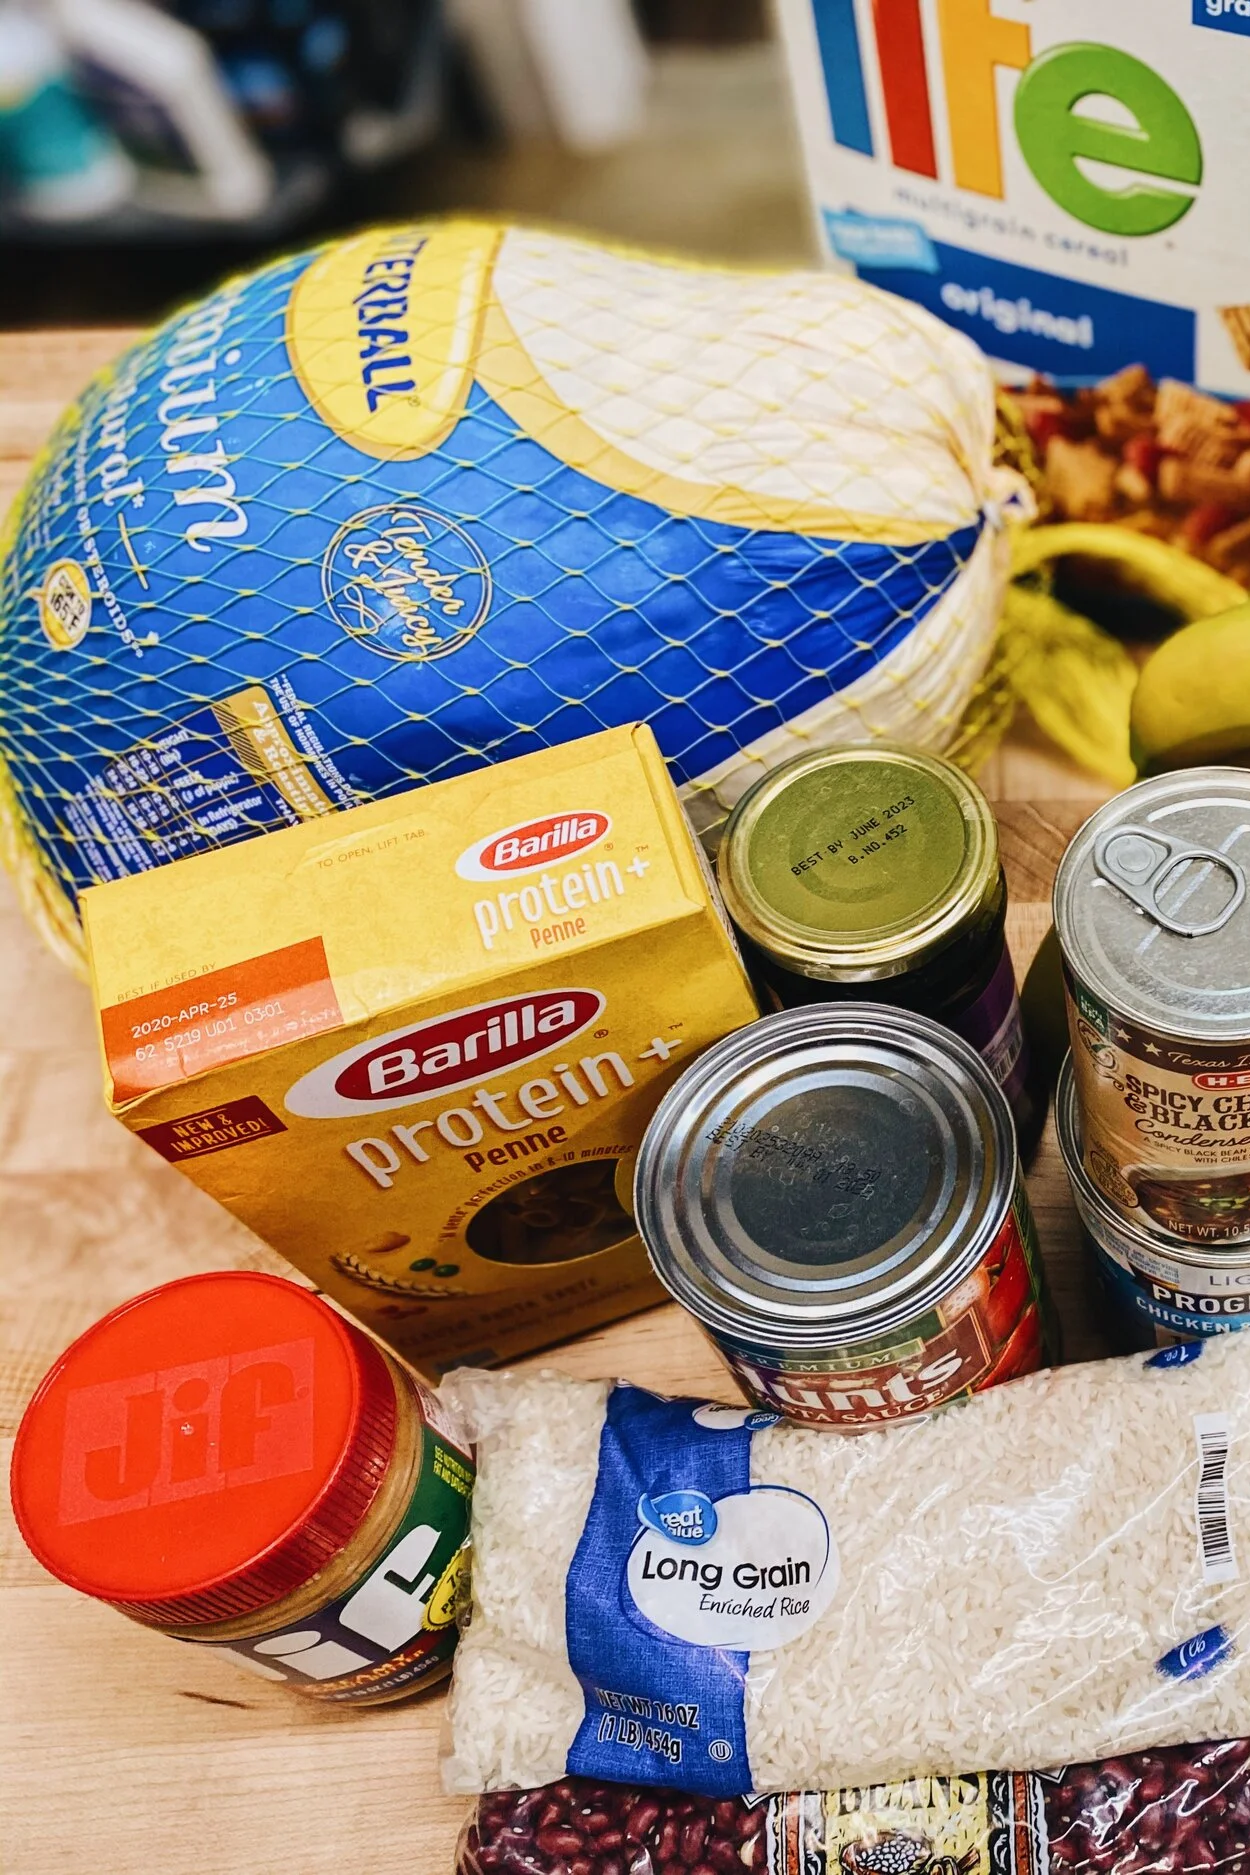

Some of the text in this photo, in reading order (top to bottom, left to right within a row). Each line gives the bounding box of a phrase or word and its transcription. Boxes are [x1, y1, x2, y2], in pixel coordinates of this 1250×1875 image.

[1043, 229, 1130, 268] cereal
[352, 236, 431, 414] TERBALL
[939, 281, 1095, 350] original
[380, 510, 466, 616] Tender
[294, 728, 328, 780] HORMNES
[318, 829, 425, 869] TO OPEN, LIFT TAB
[492, 817, 598, 868] Barilla
[791, 795, 916, 877] BEST BY JUNE 2023
[530, 917, 587, 949] Penne
[117, 960, 217, 1002] BEST IF USED BY
[131, 991, 238, 1039] 2020-APR-25
[135, 1043, 156, 1062] 62
[164, 1027, 202, 1051] 5219
[367, 994, 578, 1095] Barilla
[1167, 1049, 1231, 1070] Texas
[1123, 1091, 1148, 1115] &
[1124, 1073, 1204, 1112] SPICY
[170, 1116, 271, 1154] IMPROVED!
[173, 1111, 235, 1141] NEW &
[463, 1124, 569, 1174] Penne
[1153, 1141, 1181, 1155] SPICY
[1183, 1149, 1217, 1159] BLACK
[1219, 1147, 1248, 1158] BEAN
[1194, 1156, 1219, 1165] WITH
[464, 1168, 528, 1209] perfection
[528, 1161, 545, 1175] in
[580, 1142, 635, 1159] minutes
[1168, 1219, 1194, 1237] NET
[1196, 1225, 1221, 1238] WT.
[1223, 1223, 1250, 1238] 10.5
[1136, 1294, 1231, 1333] CHICKEN
[841, 1388, 945, 1423] SAUCE
[83, 1360, 297, 1500] Jif
[658, 1504, 706, 1529] reat
[667, 1521, 706, 1541] alue
[640, 1550, 811, 1592] Long Grain
[698, 1592, 811, 1621] Enriched Rice
[596, 1686, 701, 1731] NET WT 16 OZ
[597, 1712, 683, 1765] (1 LB) 454g
